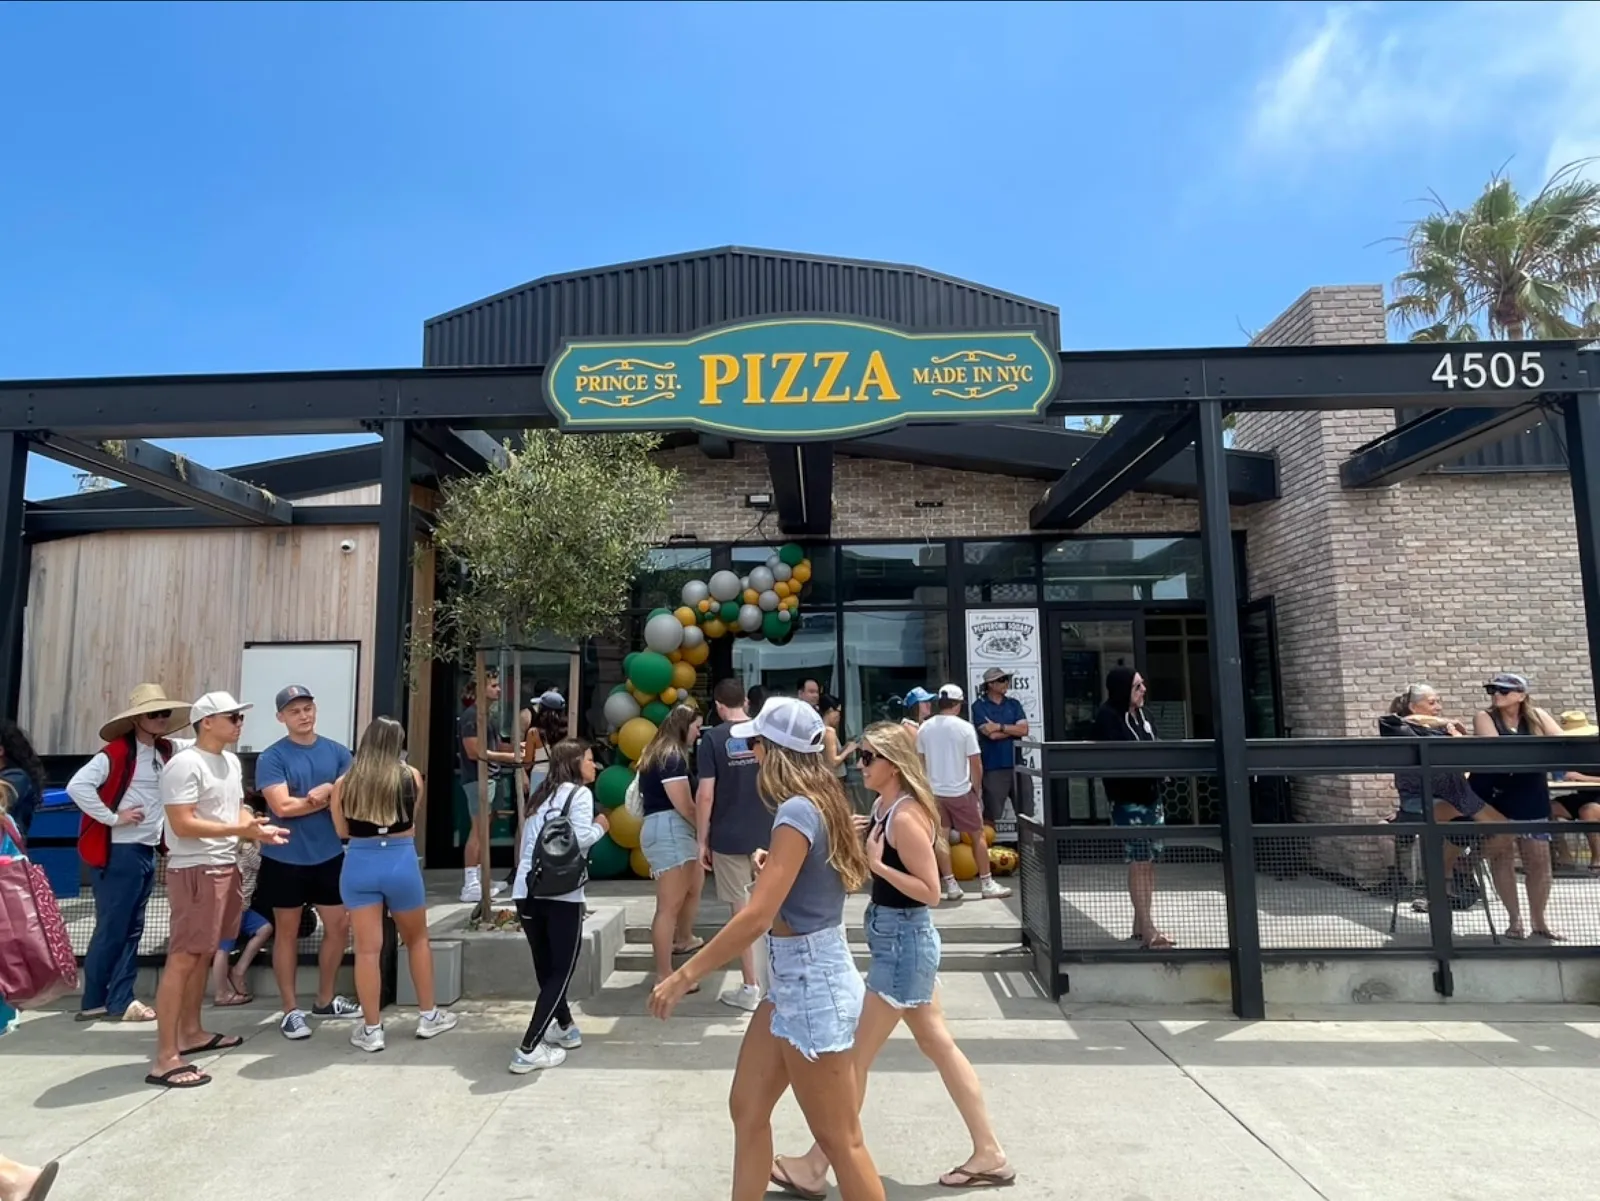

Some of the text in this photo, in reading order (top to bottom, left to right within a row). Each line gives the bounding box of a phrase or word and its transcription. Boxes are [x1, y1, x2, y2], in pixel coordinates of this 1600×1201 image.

[575, 373, 682, 392] PRINCE ST.
[699, 350, 901, 404] PIZZA
[912, 365, 1033, 385] MADE IN NYC
[1431, 351, 1545, 389] 4505
